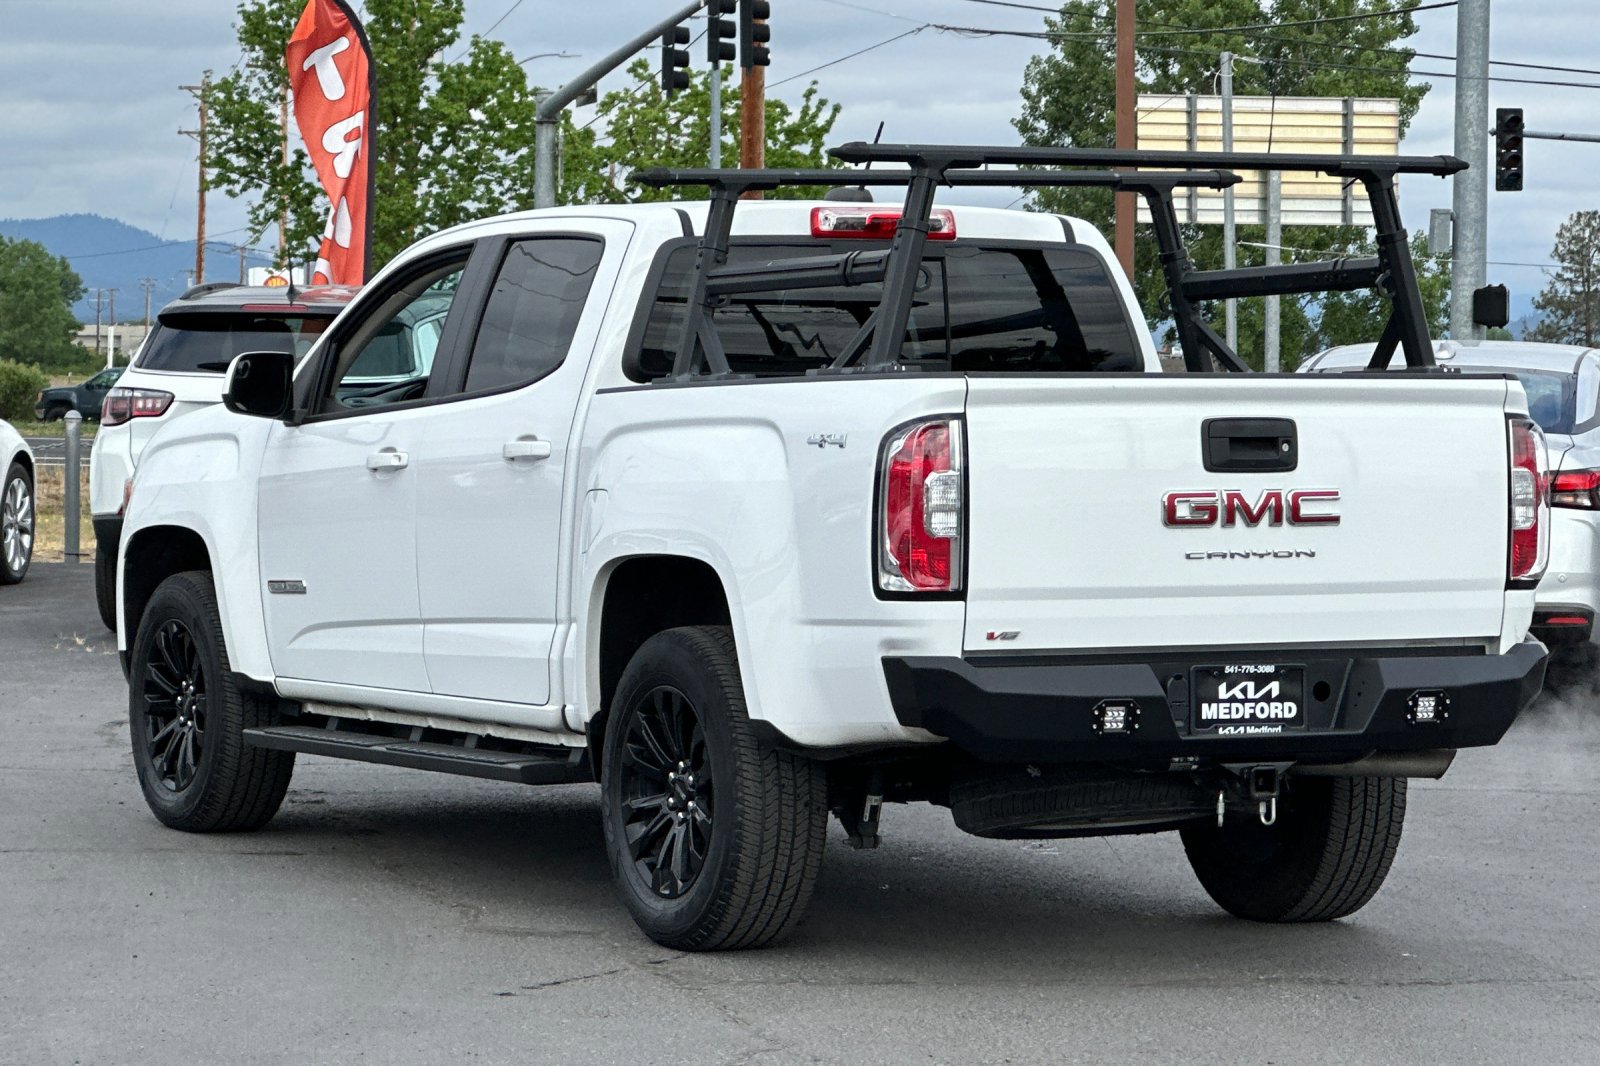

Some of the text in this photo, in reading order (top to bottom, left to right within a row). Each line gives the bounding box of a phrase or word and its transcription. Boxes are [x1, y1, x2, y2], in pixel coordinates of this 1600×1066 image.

[1161, 488, 1342, 530] GMC
[1185, 548, 1317, 561] CANYON
[1218, 680, 1280, 700] KIA
[1201, 701, 1298, 720] MEDFORD
[1246, 725, 1282, 735] Medford
